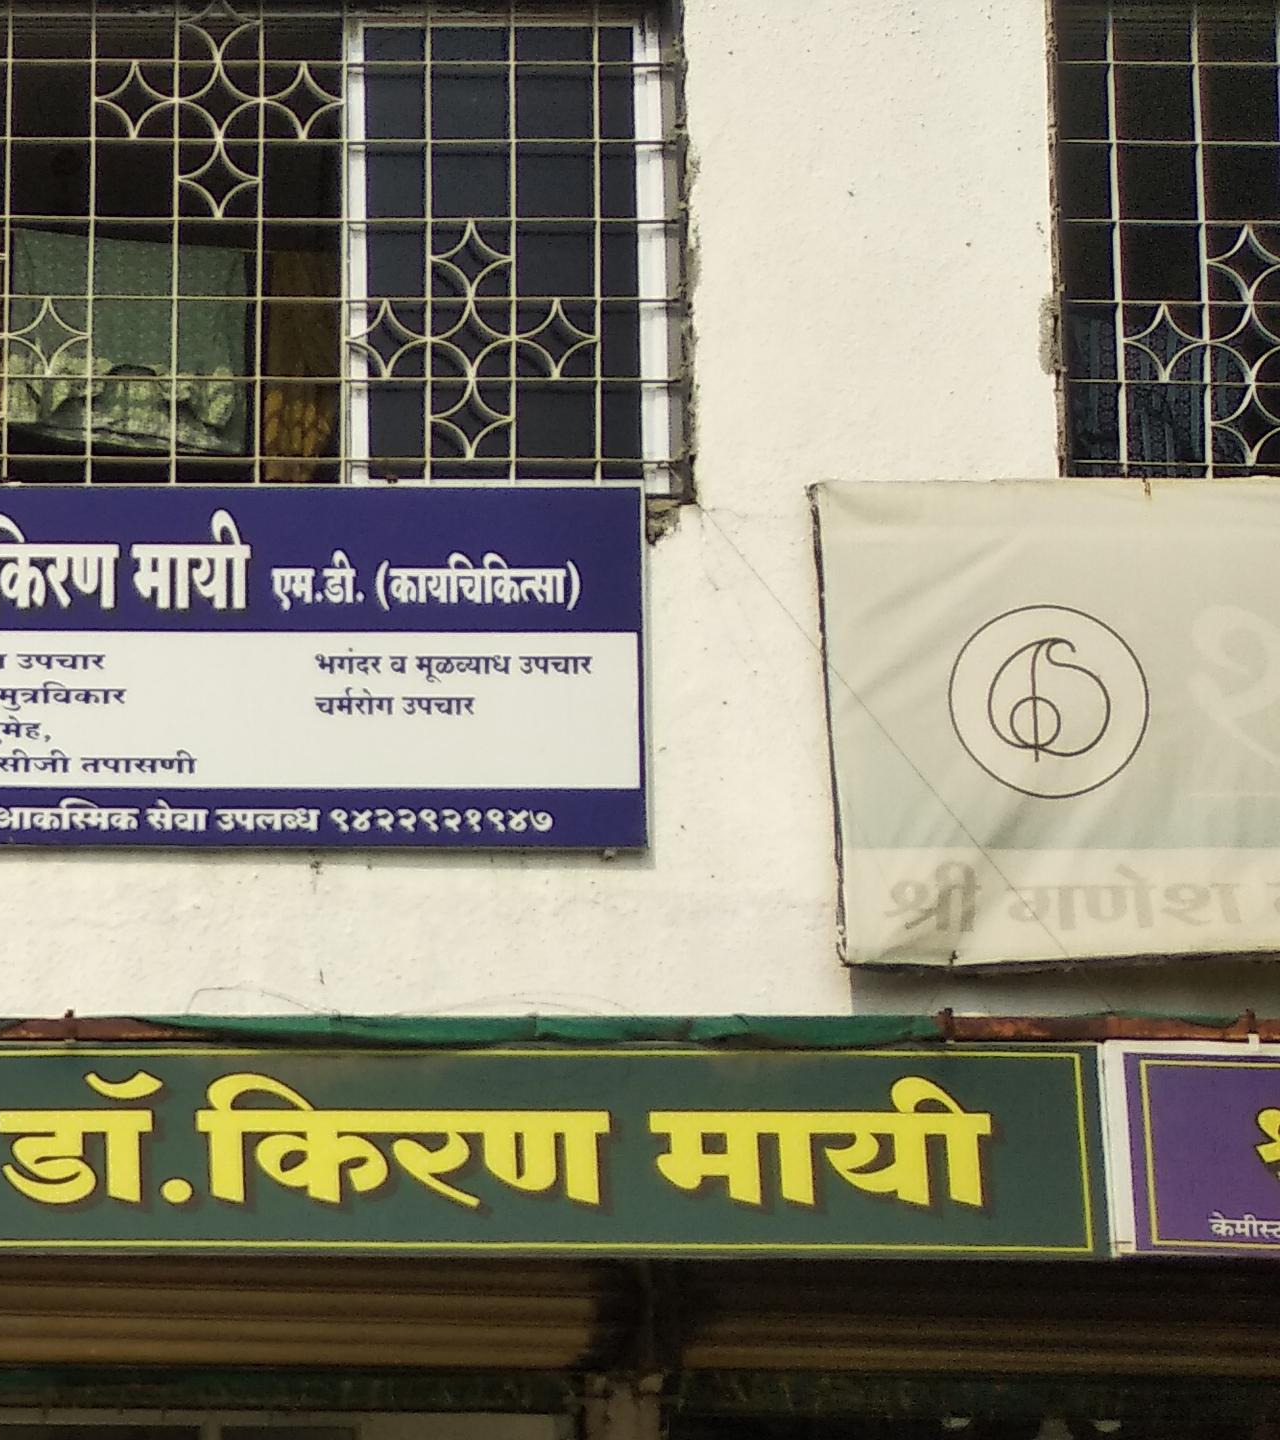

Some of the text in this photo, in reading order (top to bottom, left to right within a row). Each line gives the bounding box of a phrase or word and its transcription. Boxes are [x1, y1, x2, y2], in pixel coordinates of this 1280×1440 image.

[130, 509, 251, 610] मायी
[271, 550, 366, 612] एम.डी.
[375, 551, 582, 613] (कायचिकित्सा)
[16, 653, 107, 671] उपचार
[314, 647, 593, 683] भगंदर व मूळव्याध उपचार
[314, 686, 476, 716] चर्मरोग उपचार
[81, 749, 199, 776] तपासणी
[145, 799, 211, 832] सेवा
[215, 806, 322, 833] उपलब्ध
[328, 806, 556, 834] ९४२२९२१९४७
[884, 860, 982, 933] श्री
[648, 1074, 994, 1206] मायी
